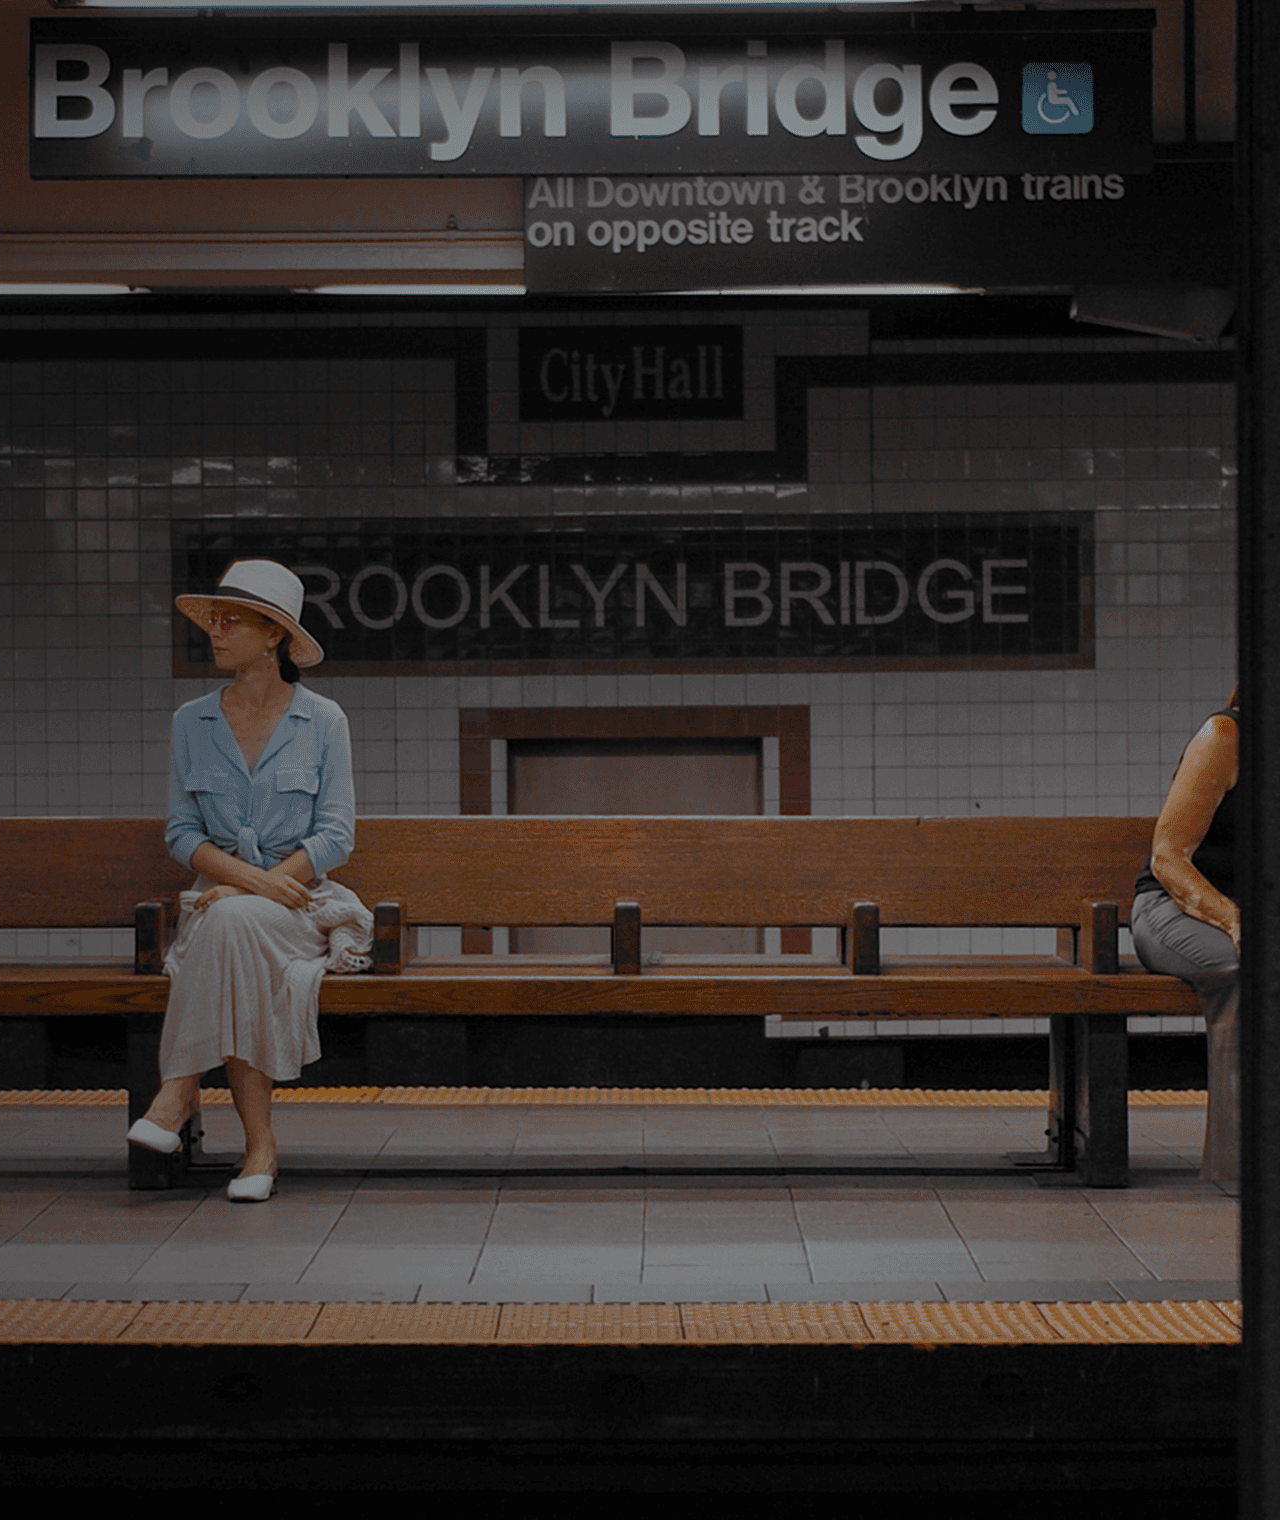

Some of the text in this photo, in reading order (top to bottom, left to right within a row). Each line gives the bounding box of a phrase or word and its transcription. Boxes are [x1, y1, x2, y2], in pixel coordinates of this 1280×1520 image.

[34, 39, 999, 161] Brooklyn Bridge
[528, 173, 1126, 210] All Downtown & Brooklyn trains
[527, 208, 864, 253] on opposite track
[540, 345, 725, 417] City Hall
[290, 558, 1029, 630] ROOKLYN BRIDGE
